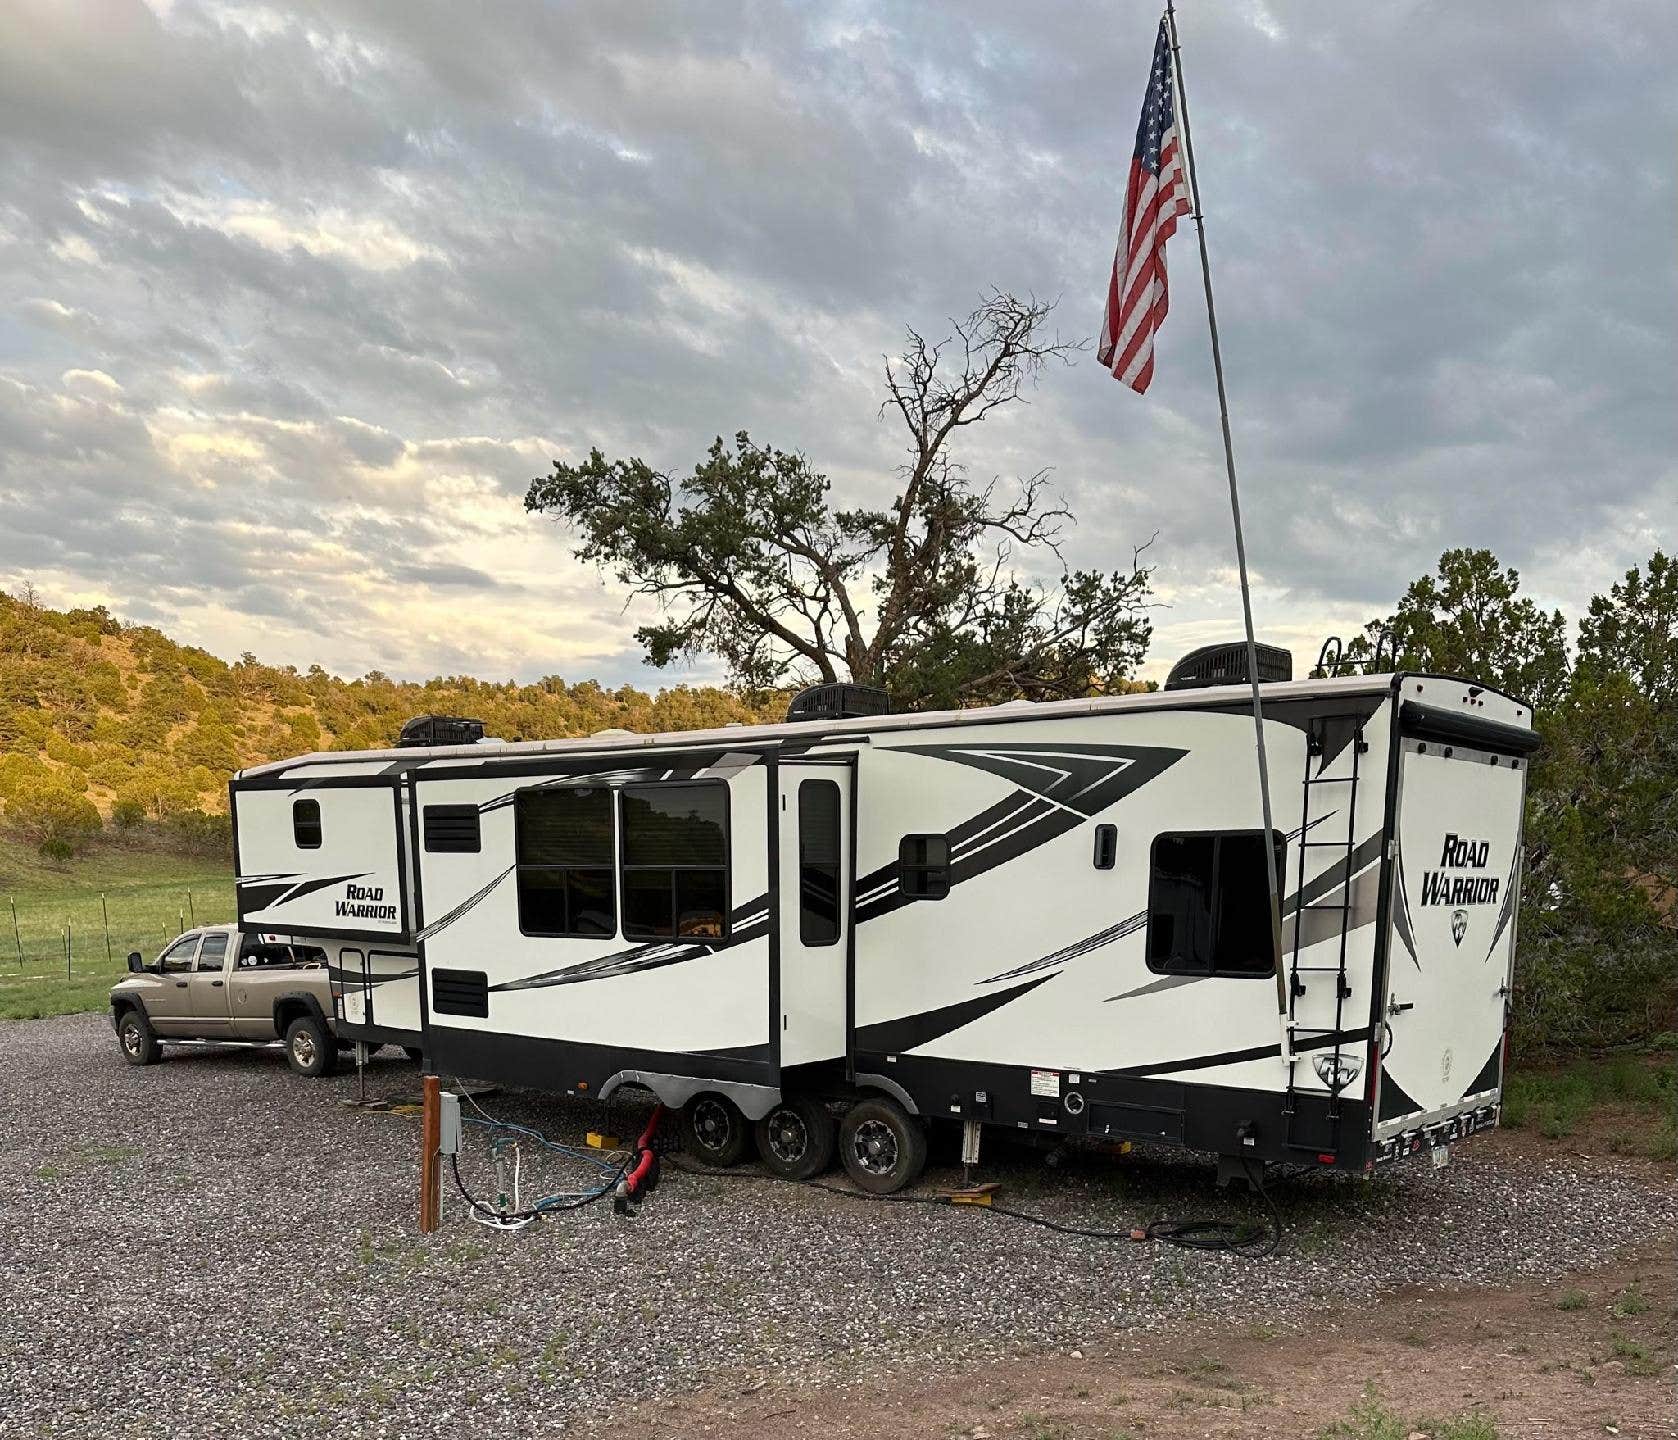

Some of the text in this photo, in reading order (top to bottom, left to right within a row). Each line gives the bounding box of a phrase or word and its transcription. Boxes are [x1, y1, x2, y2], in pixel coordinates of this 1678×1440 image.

[1440, 833, 1490, 868] ROAD
[346, 884, 384, 901] ROAD
[1421, 870, 1500, 907] WARRIOR
[335, 901, 397, 920] WARRIOR
